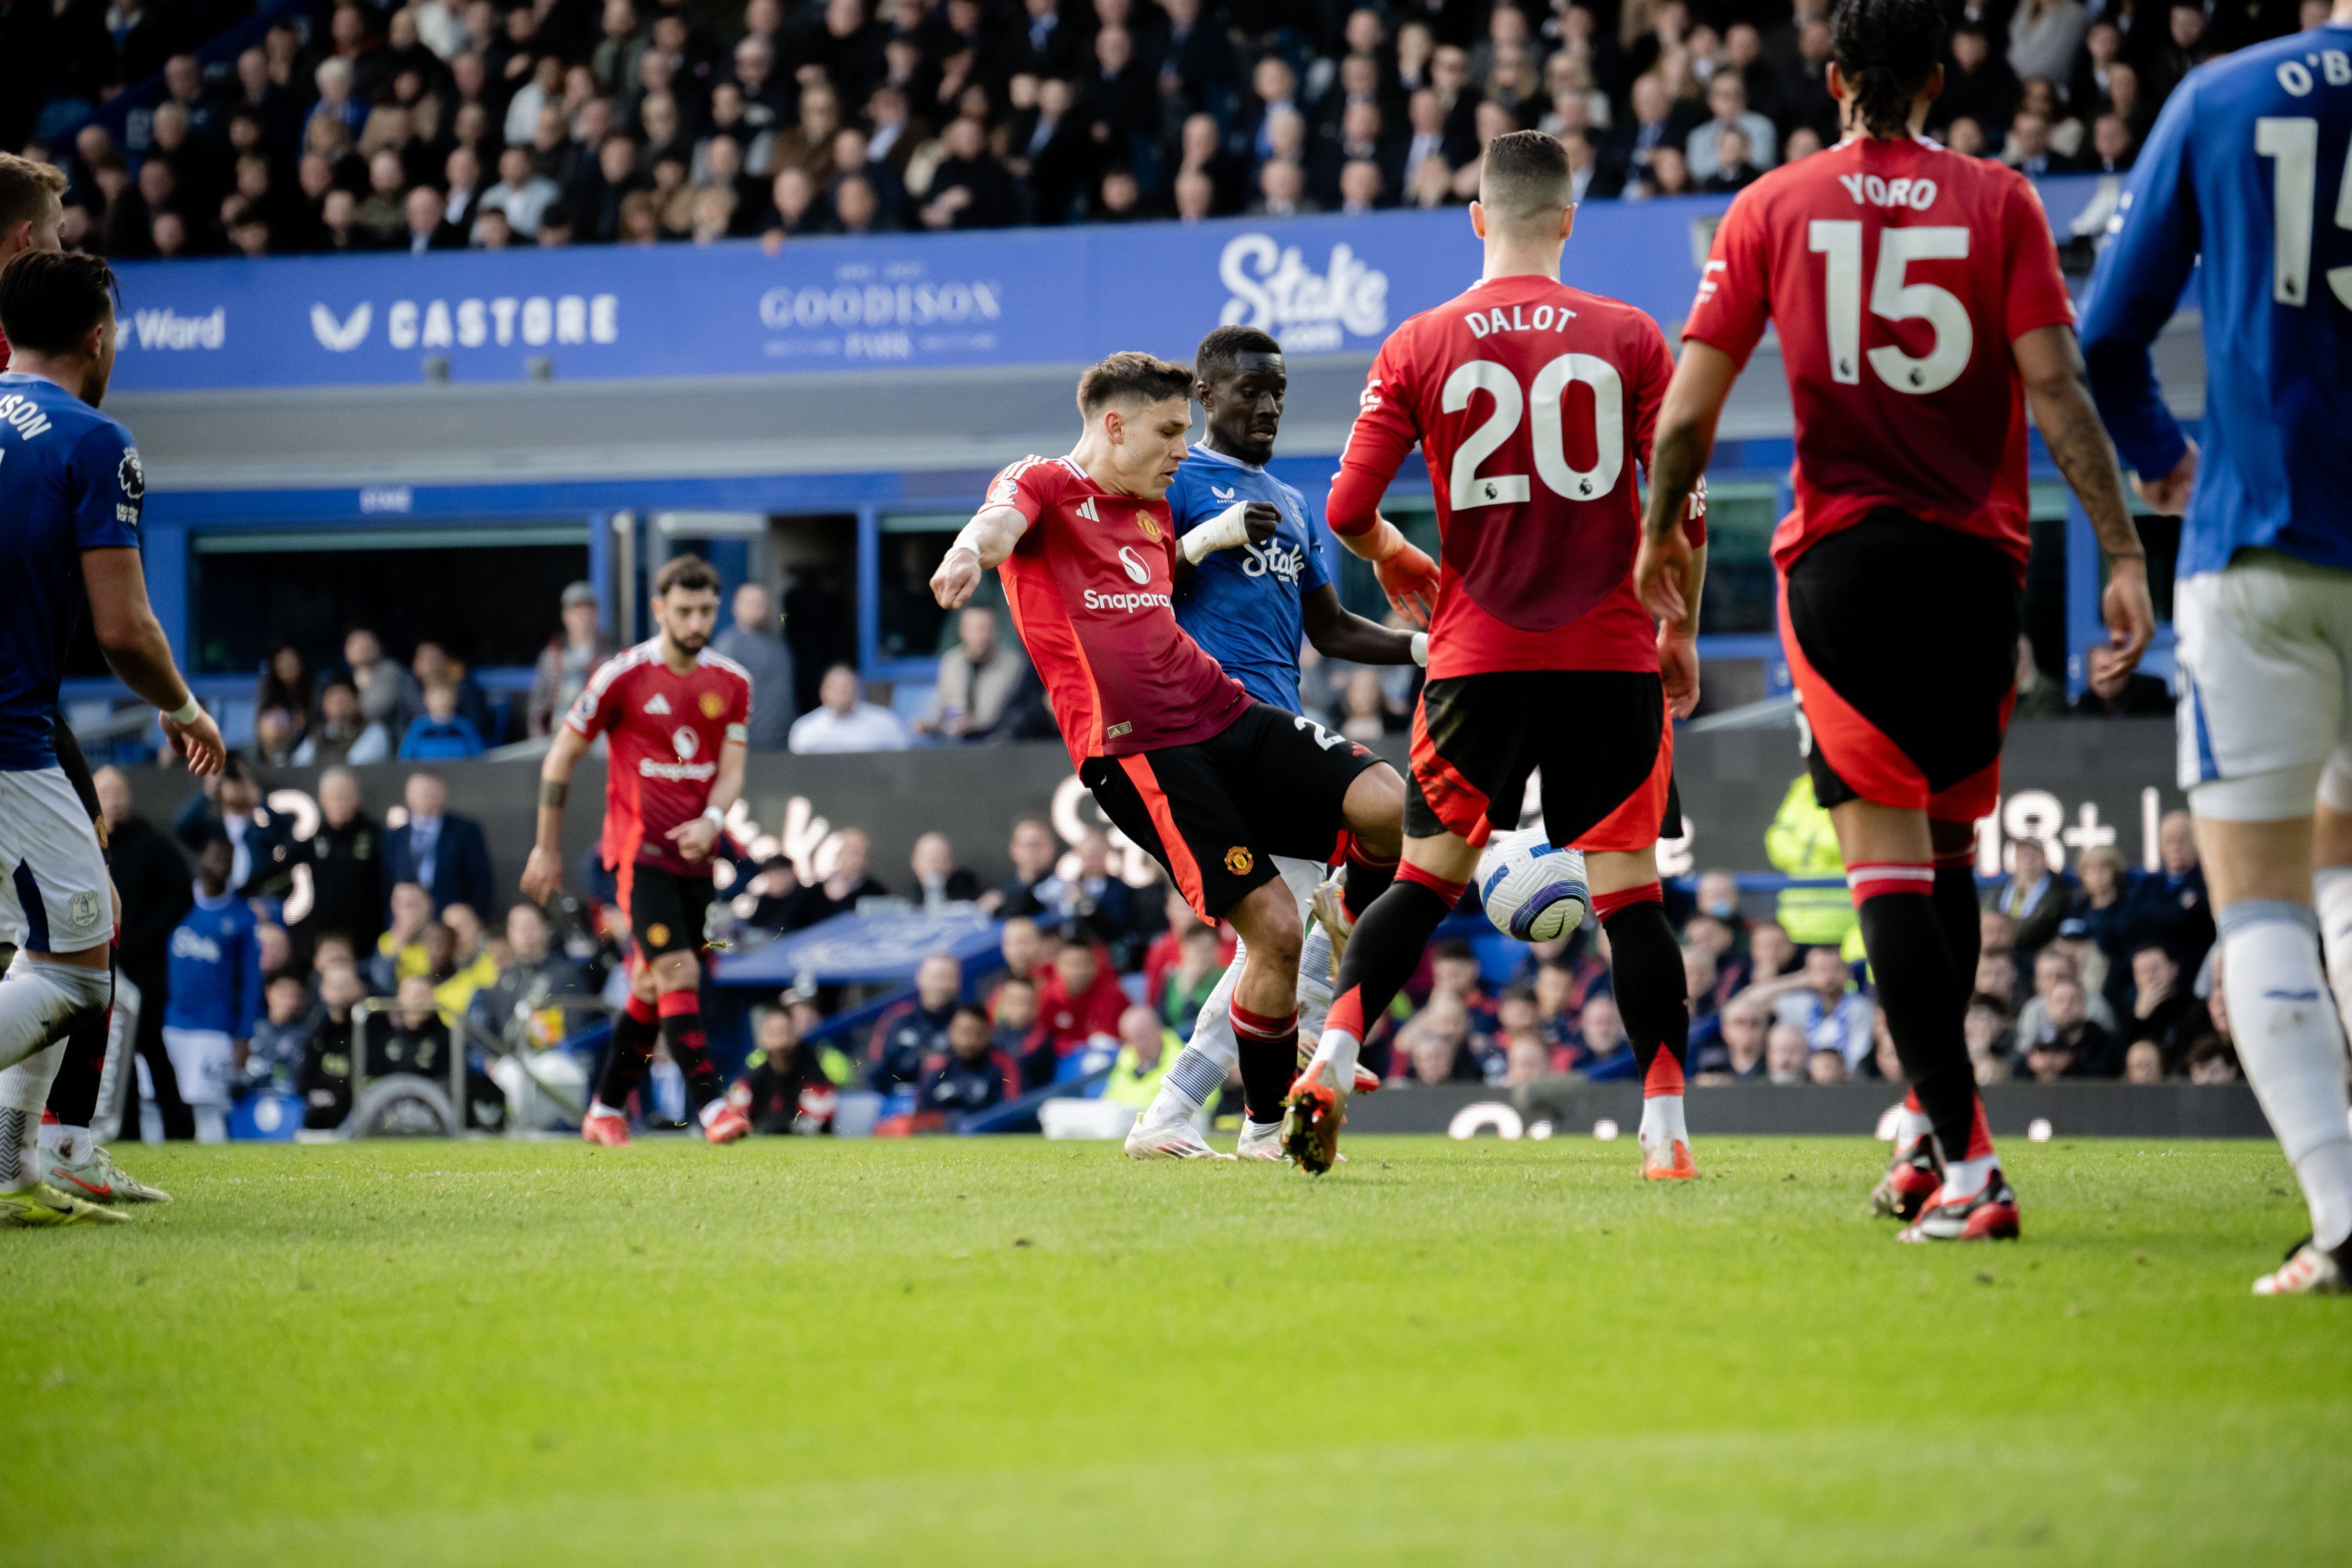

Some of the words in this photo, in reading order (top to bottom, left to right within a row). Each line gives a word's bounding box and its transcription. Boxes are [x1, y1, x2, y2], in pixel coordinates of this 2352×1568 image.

[1840, 173, 1937, 211] YORO
[759, 279, 1002, 330] GOODISON
[1219, 233, 1389, 338] Stake
[1808, 219, 1974, 394] 15
[135, 305, 226, 351] Ward
[389, 293, 619, 349] CASTORE
[1464, 305, 1577, 339] DALOT
[1442, 353, 1623, 511] 20
[1242, 537, 1305, 587] Stake
[1294, 716, 1347, 751] 2
